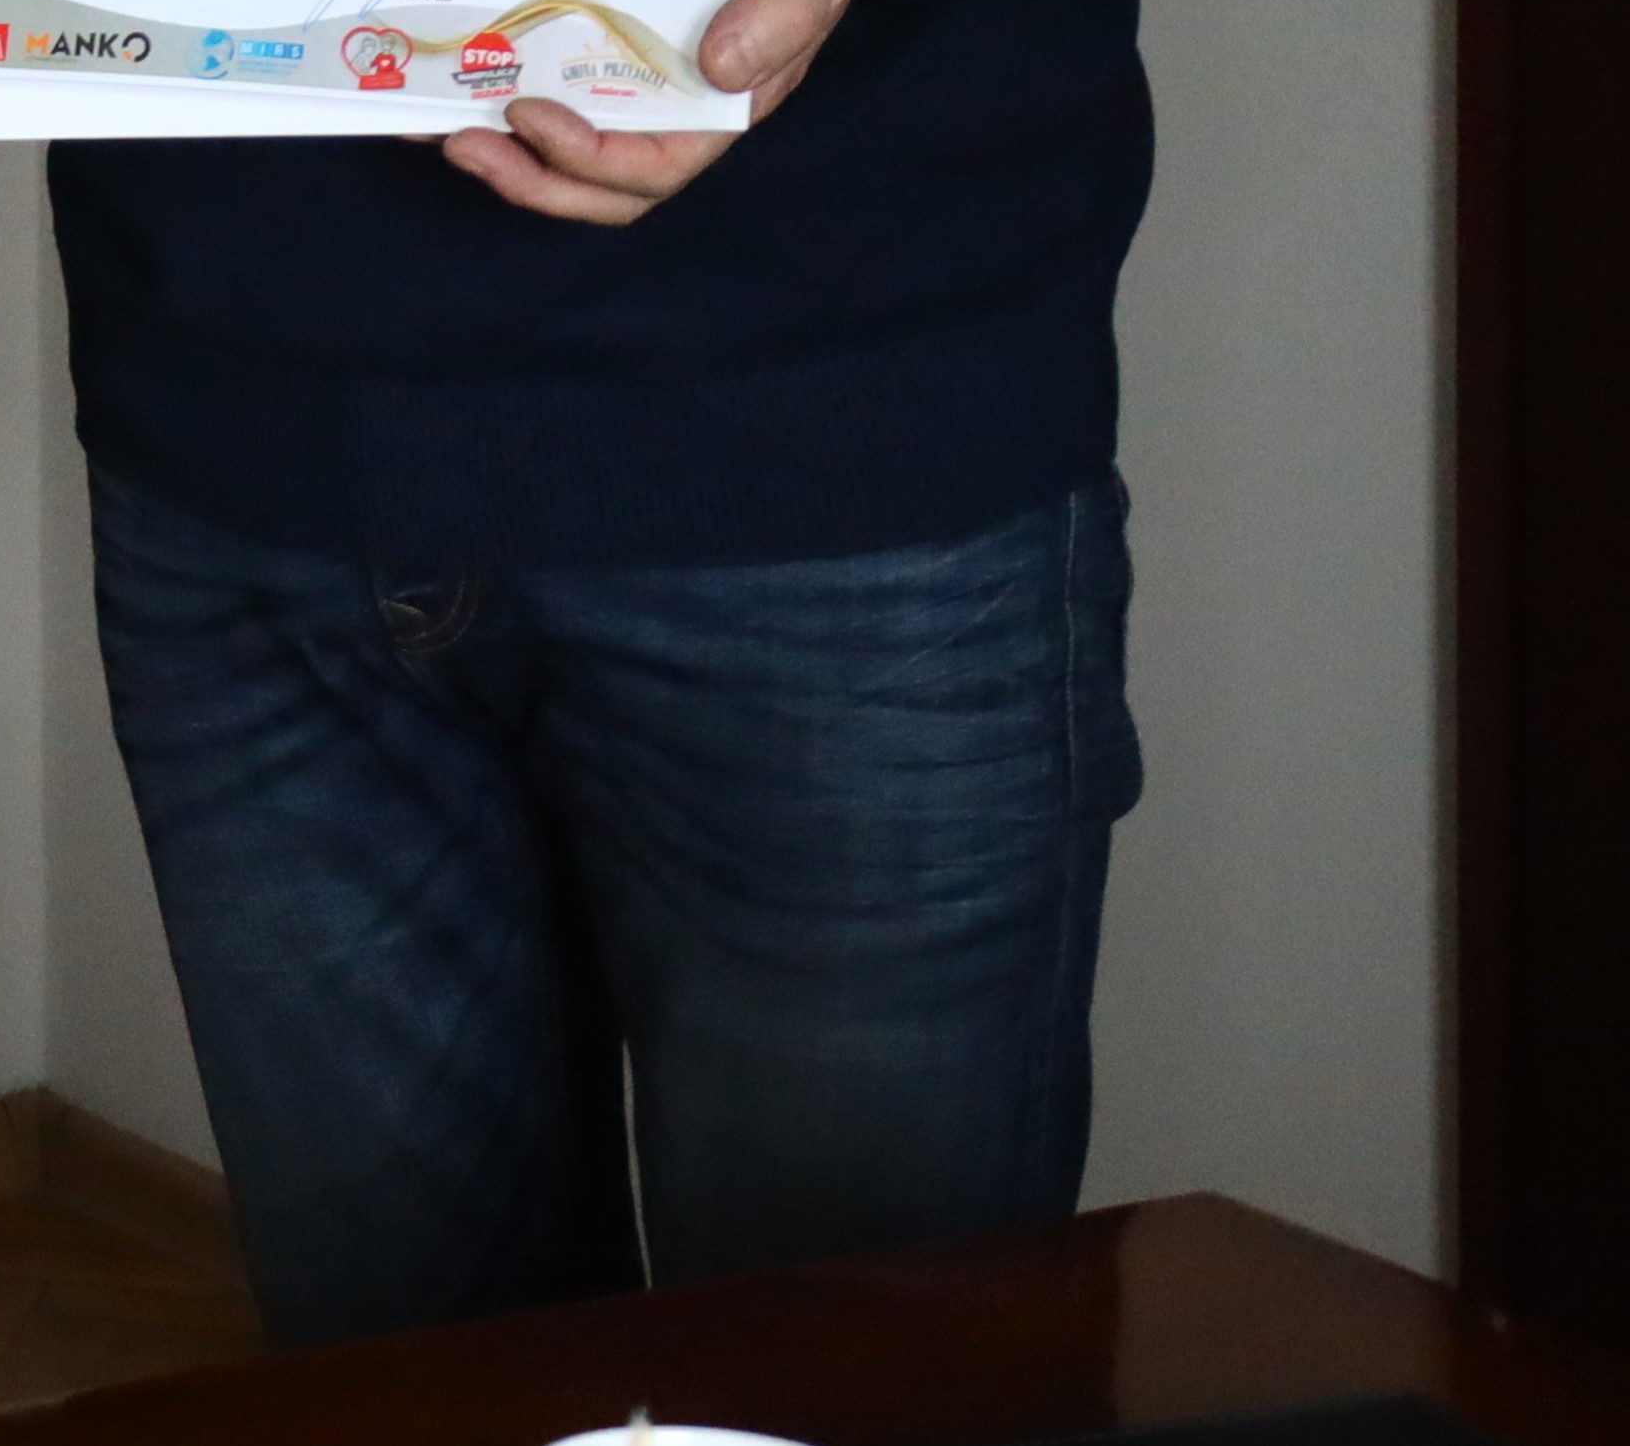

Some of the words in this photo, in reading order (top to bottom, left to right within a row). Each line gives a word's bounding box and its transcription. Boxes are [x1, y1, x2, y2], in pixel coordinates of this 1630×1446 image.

[26, 31, 151, 63] MANKO
[240, 41, 301, 58] MIRS
[464, 49, 513, 65] STOP
